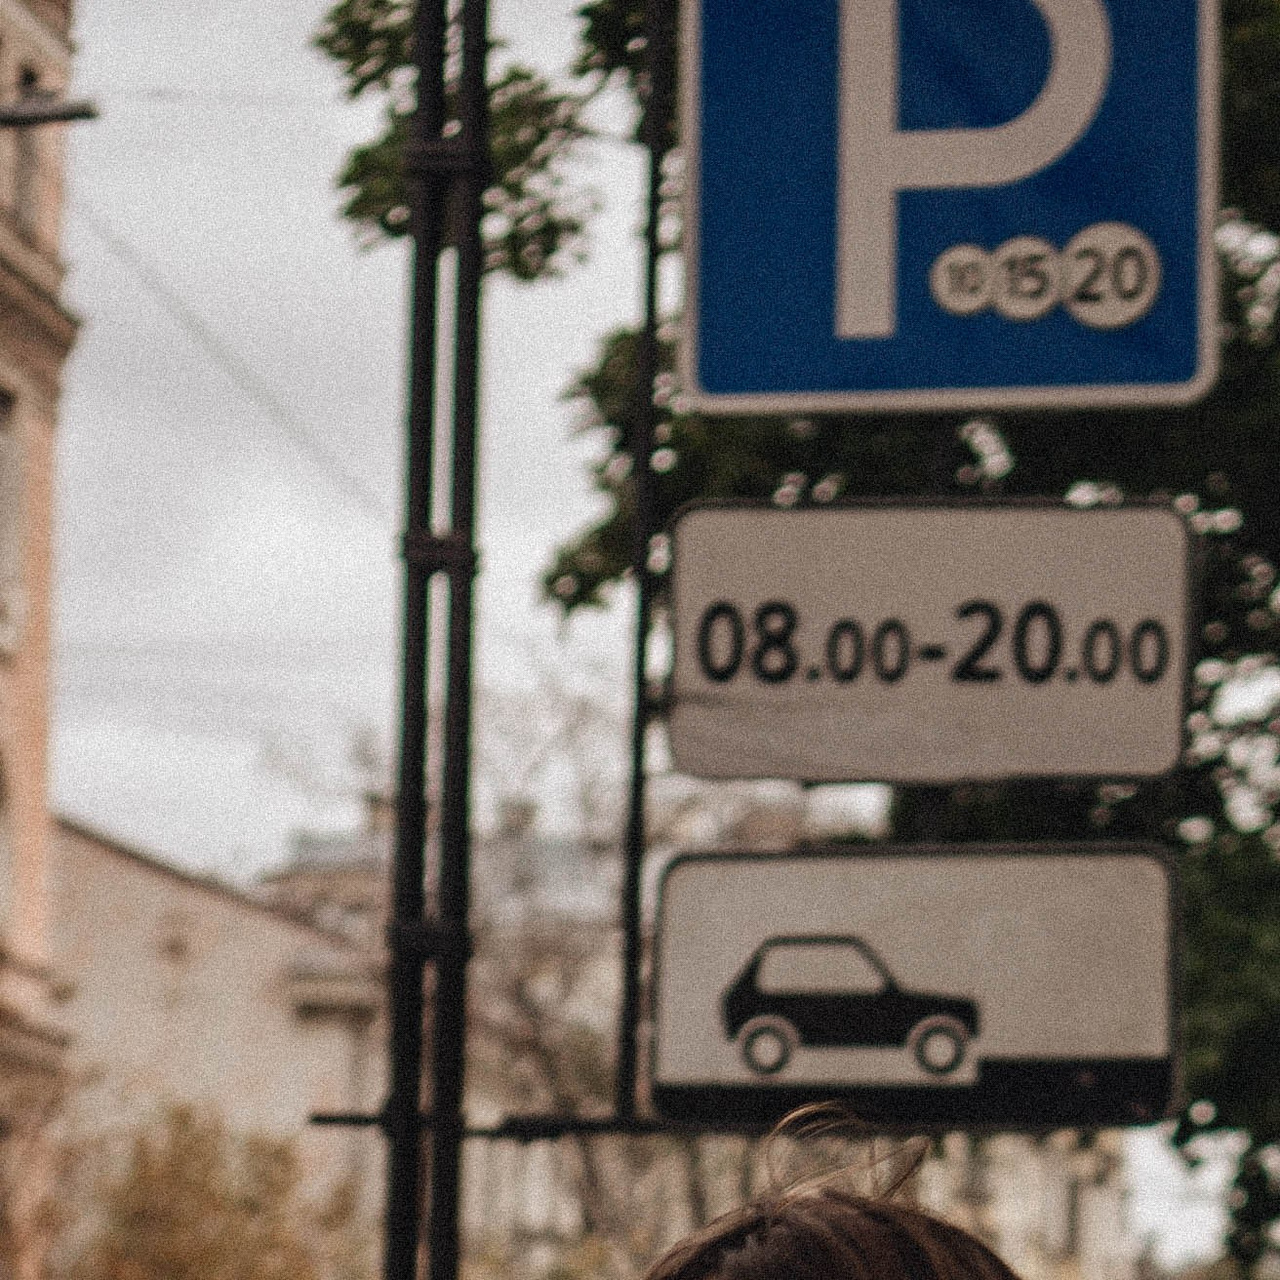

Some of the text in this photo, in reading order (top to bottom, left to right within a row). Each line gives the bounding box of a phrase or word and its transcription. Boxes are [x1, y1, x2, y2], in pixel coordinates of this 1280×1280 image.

[834, 0, 1113, 339] P
[1004, 252, 1053, 300] 15
[1073, 245, 1149, 302] 20
[699, 600, 1170, 684] 08.00-20.00
